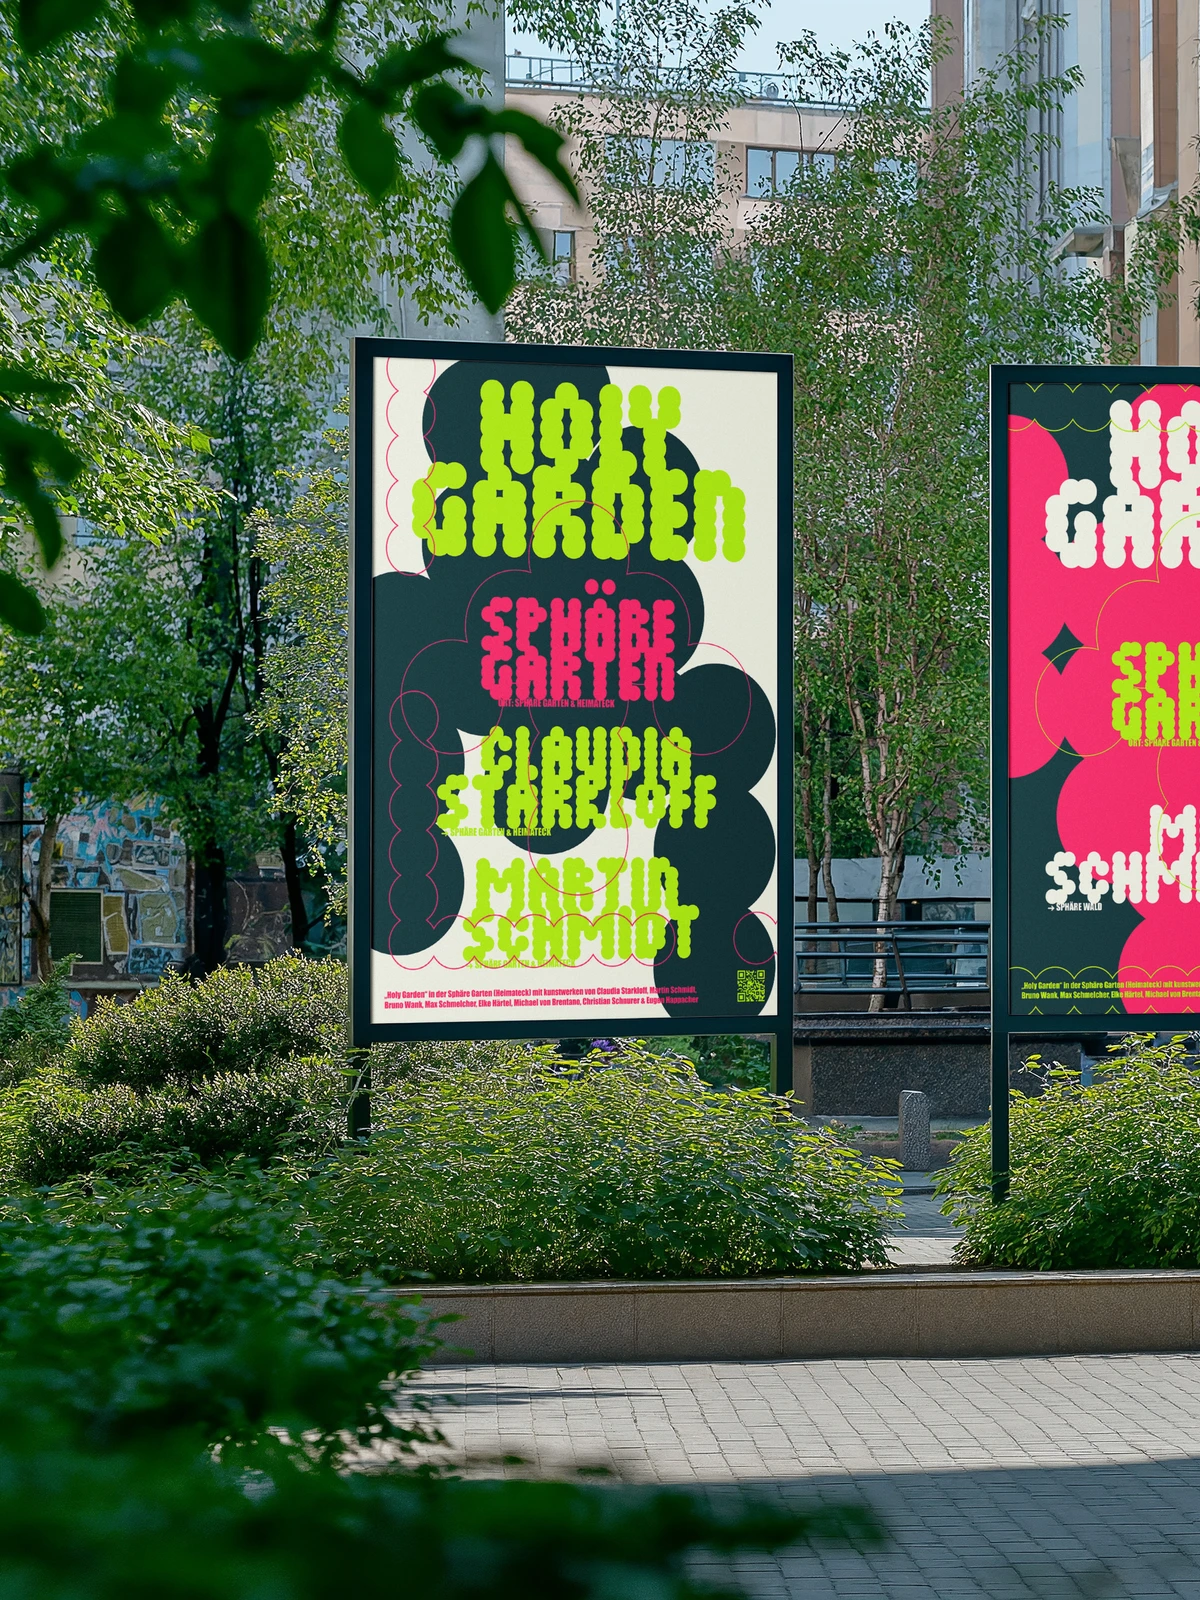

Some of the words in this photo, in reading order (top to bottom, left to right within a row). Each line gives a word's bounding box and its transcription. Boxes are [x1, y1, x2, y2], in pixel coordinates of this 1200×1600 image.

[480, 379, 682, 476] HOLY
[412, 464, 746, 562] GARDEN
[481, 579, 675, 662] SPHÄRE
[481, 646, 675, 701] GARTEN
[481, 726, 692, 781] CLAUDIA
[437, 773, 716, 830] STARKLOFF
[476, 857, 679, 912] MARTIN
[1056, 902, 1082, 911] SPHÄRE
[1083, 902, 1102, 911] WALD
[462, 904, 700, 960] SCHMIDT
